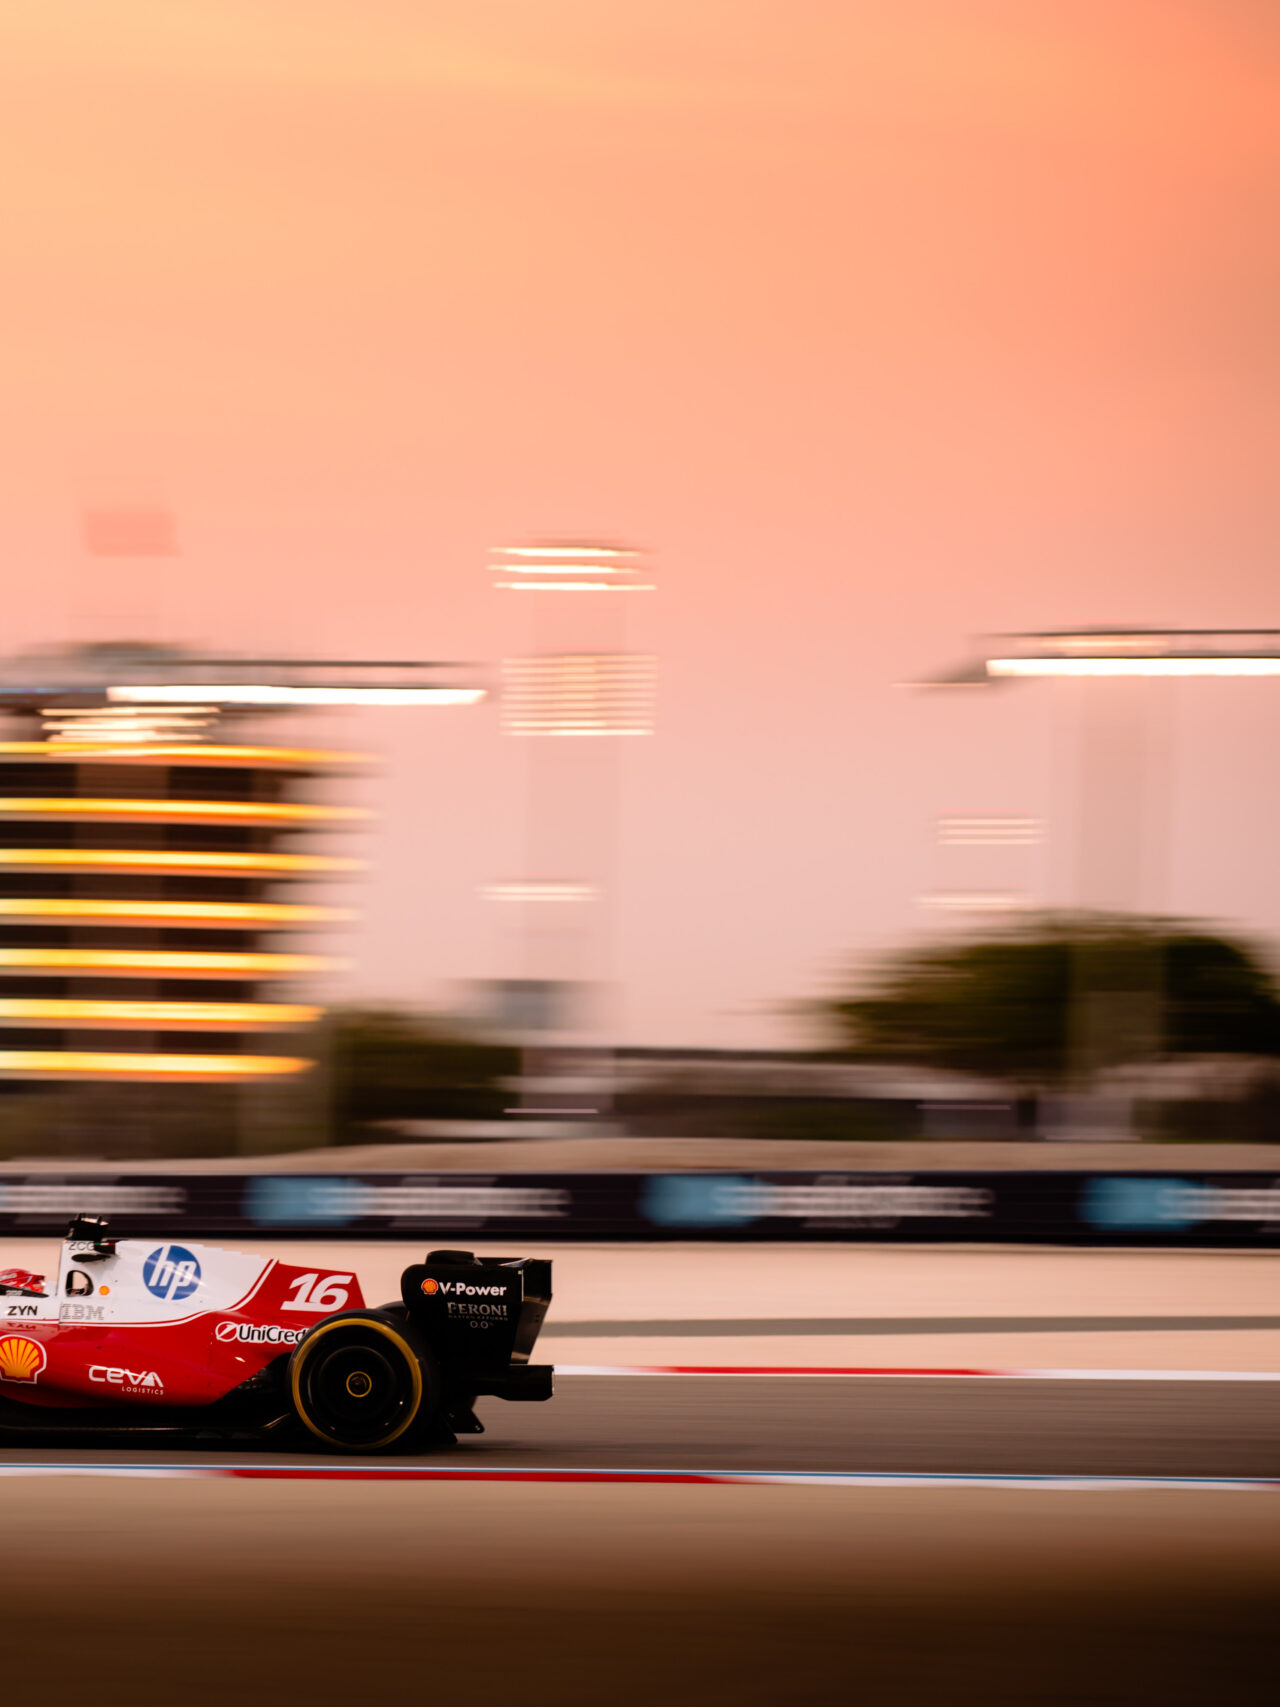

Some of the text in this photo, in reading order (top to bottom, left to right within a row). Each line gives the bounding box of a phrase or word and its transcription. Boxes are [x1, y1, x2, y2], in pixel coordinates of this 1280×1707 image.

[146, 1245, 199, 1300] hp
[280, 1273, 353, 1312] 16
[439, 1281, 507, 1296] V-Power
[7, 1305, 38, 1316] ZYN
[61, 1303, 104, 1320] IBM
[447, 1301, 508, 1316] PERONI
[238, 1323, 307, 1343] UniCred
[122, 1386, 164, 1395] LOGISTICS
